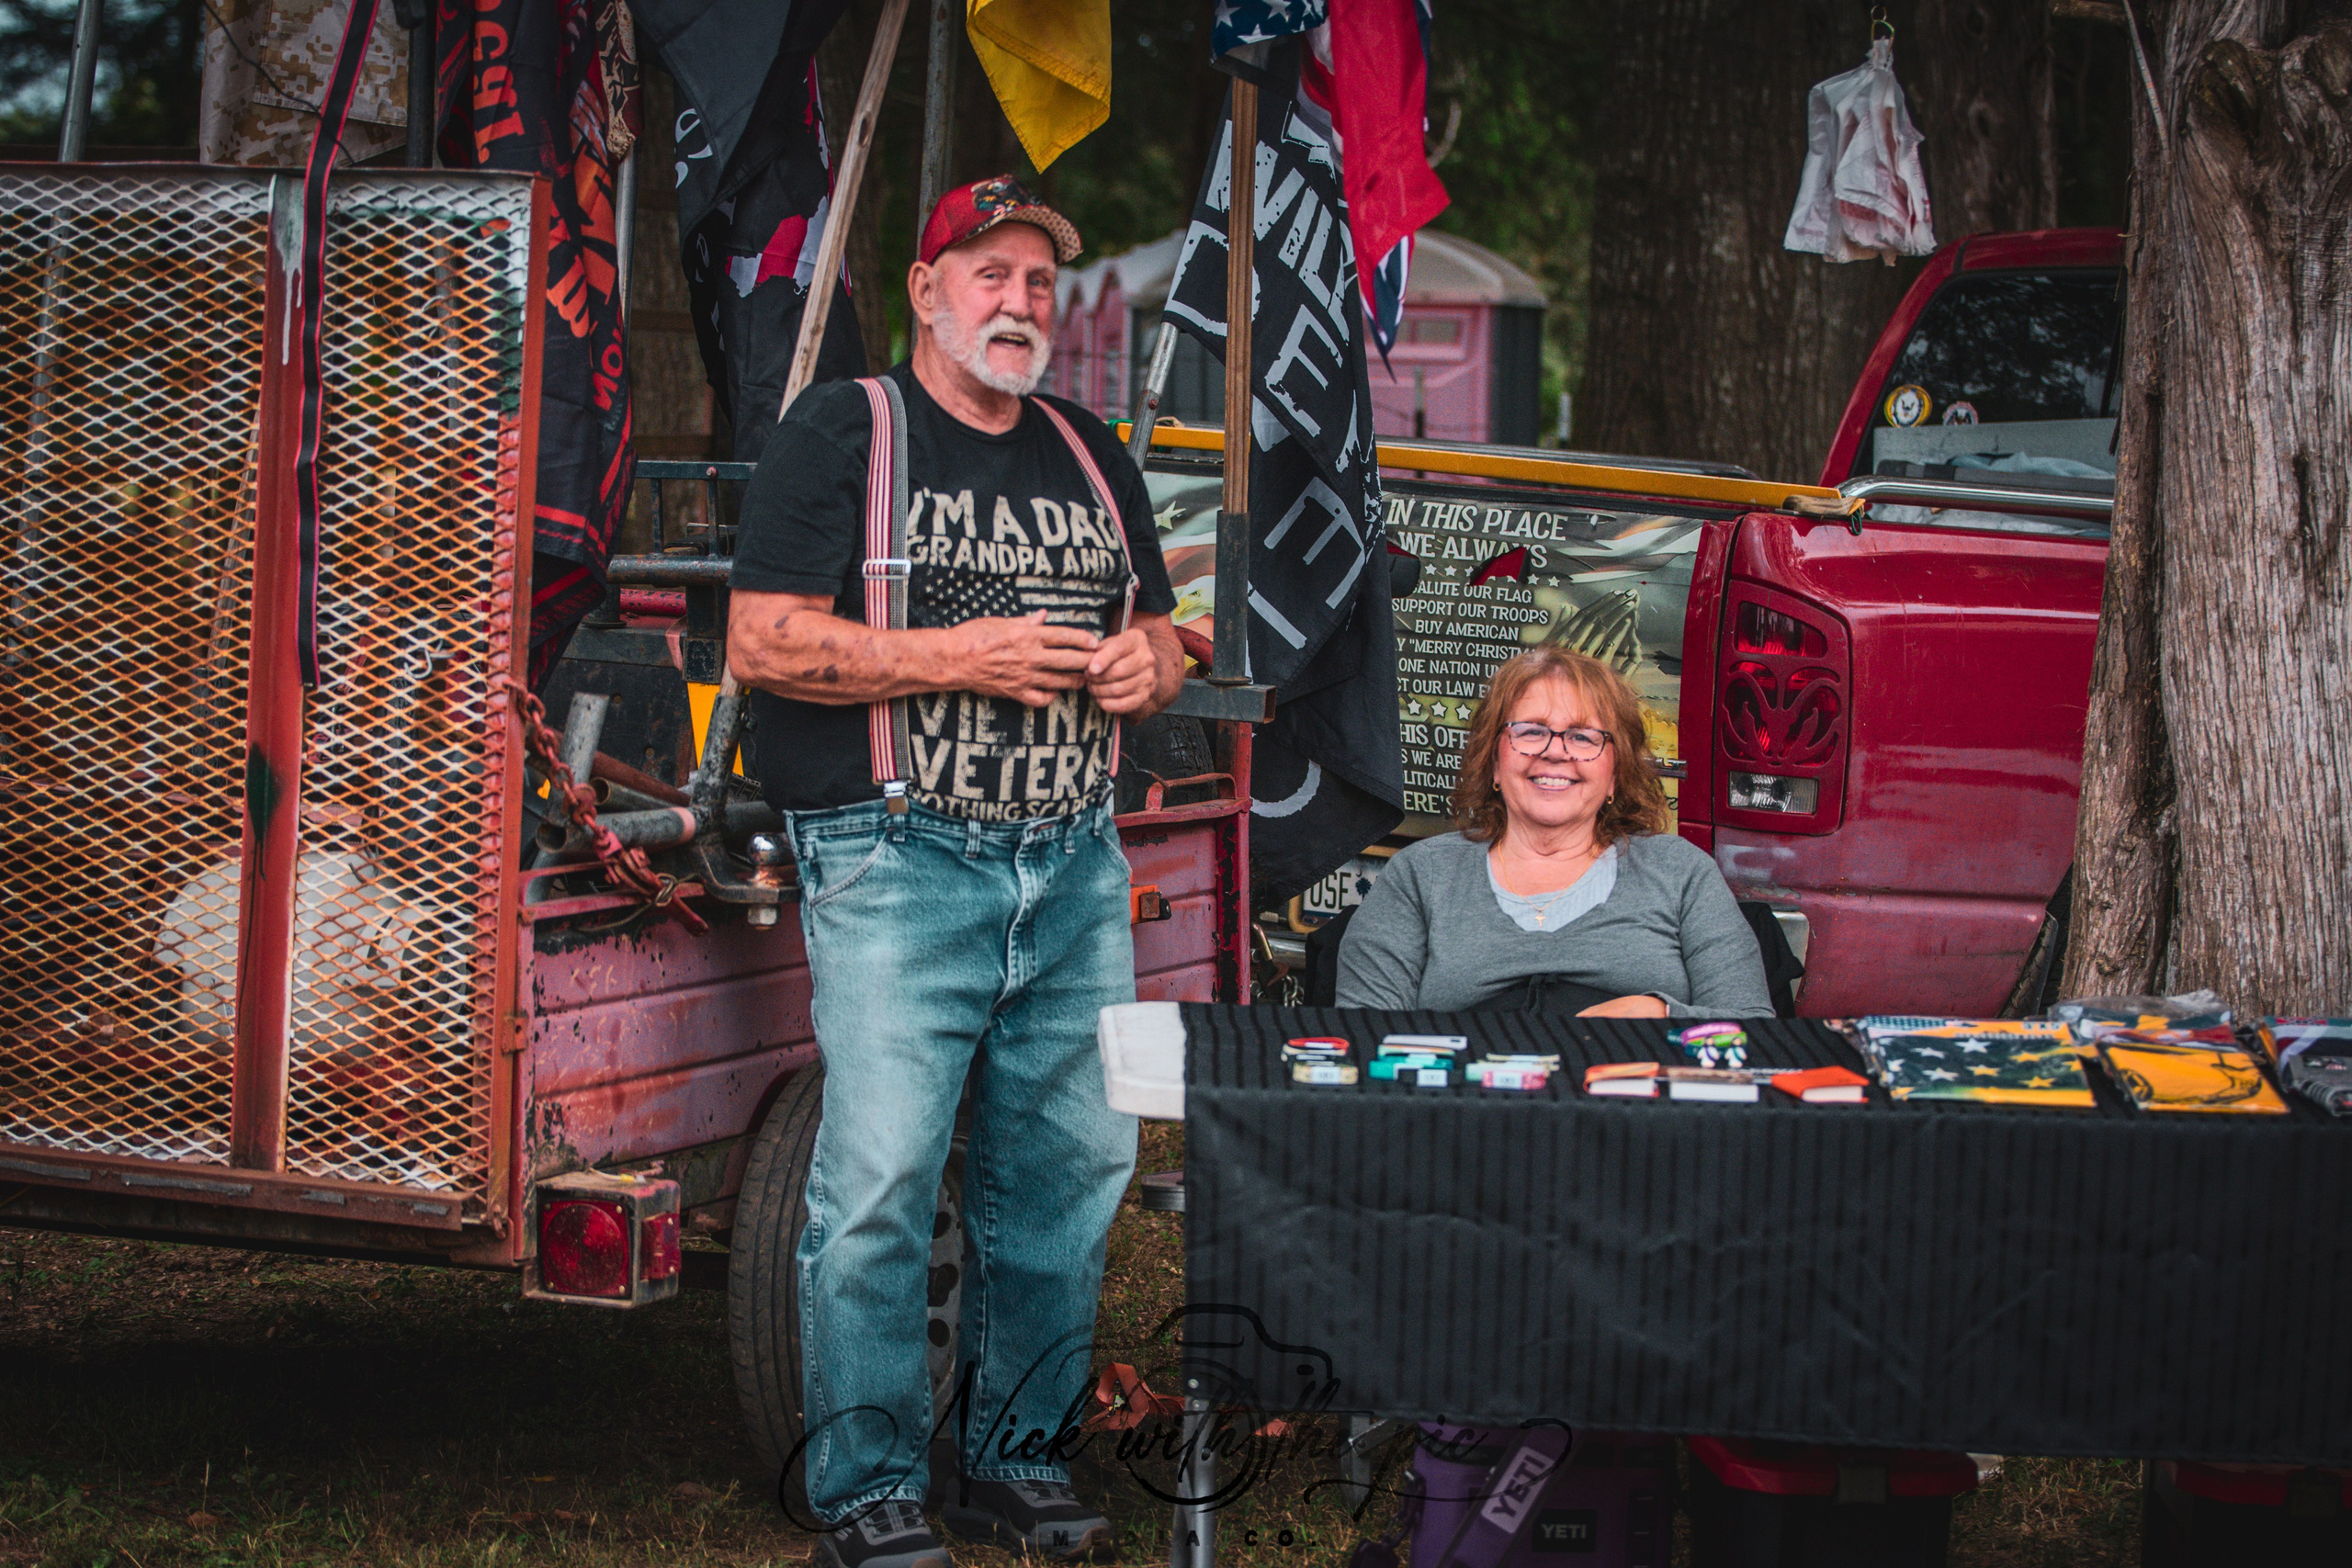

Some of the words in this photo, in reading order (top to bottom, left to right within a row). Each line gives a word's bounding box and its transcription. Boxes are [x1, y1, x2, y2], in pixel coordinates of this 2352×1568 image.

[908, 487, 977, 538] I'M
[993, 495, 1030, 545] A
[1030, 497, 1120, 550] DAD
[1385, 498, 1416, 525] IN
[1421, 502, 1477, 532] THIS
[1482, 508, 1568, 541] PLACE
[908, 535, 1054, 575] GRANDPA
[1061, 547, 1115, 579] AND
[1397, 531, 1435, 558] WE
[1442, 536, 1547, 568] ALWAS
[1464, 584, 1492, 600] OUR
[1497, 588, 1532, 604] FLAG
[1391, 598, 1454, 615] SUPPORT
[1458, 603, 1487, 619] OUR
[1490, 605, 1549, 625] TROOPS
[1415, 619, 1442, 634] BUY
[1445, 622, 1519, 641] AMERICAN
[1409, 638, 1463, 655] "MERRY
[1398, 658, 1425, 672] ONE
[1430, 660, 1480, 677] NATION
[1412, 679, 1442, 694] OUR
[1446, 681, 1475, 697] LAW
[1399, 723, 1429, 746] HIS
[910, 734, 1111, 802] VETERA
[1411, 750, 1431, 766] WE
[1435, 753, 1462, 770] ARE
[1403, 790, 1456, 816] ERE'S
[1492, 1454, 1546, 1522] YETI
[1541, 1524, 1587, 1539] YETI
